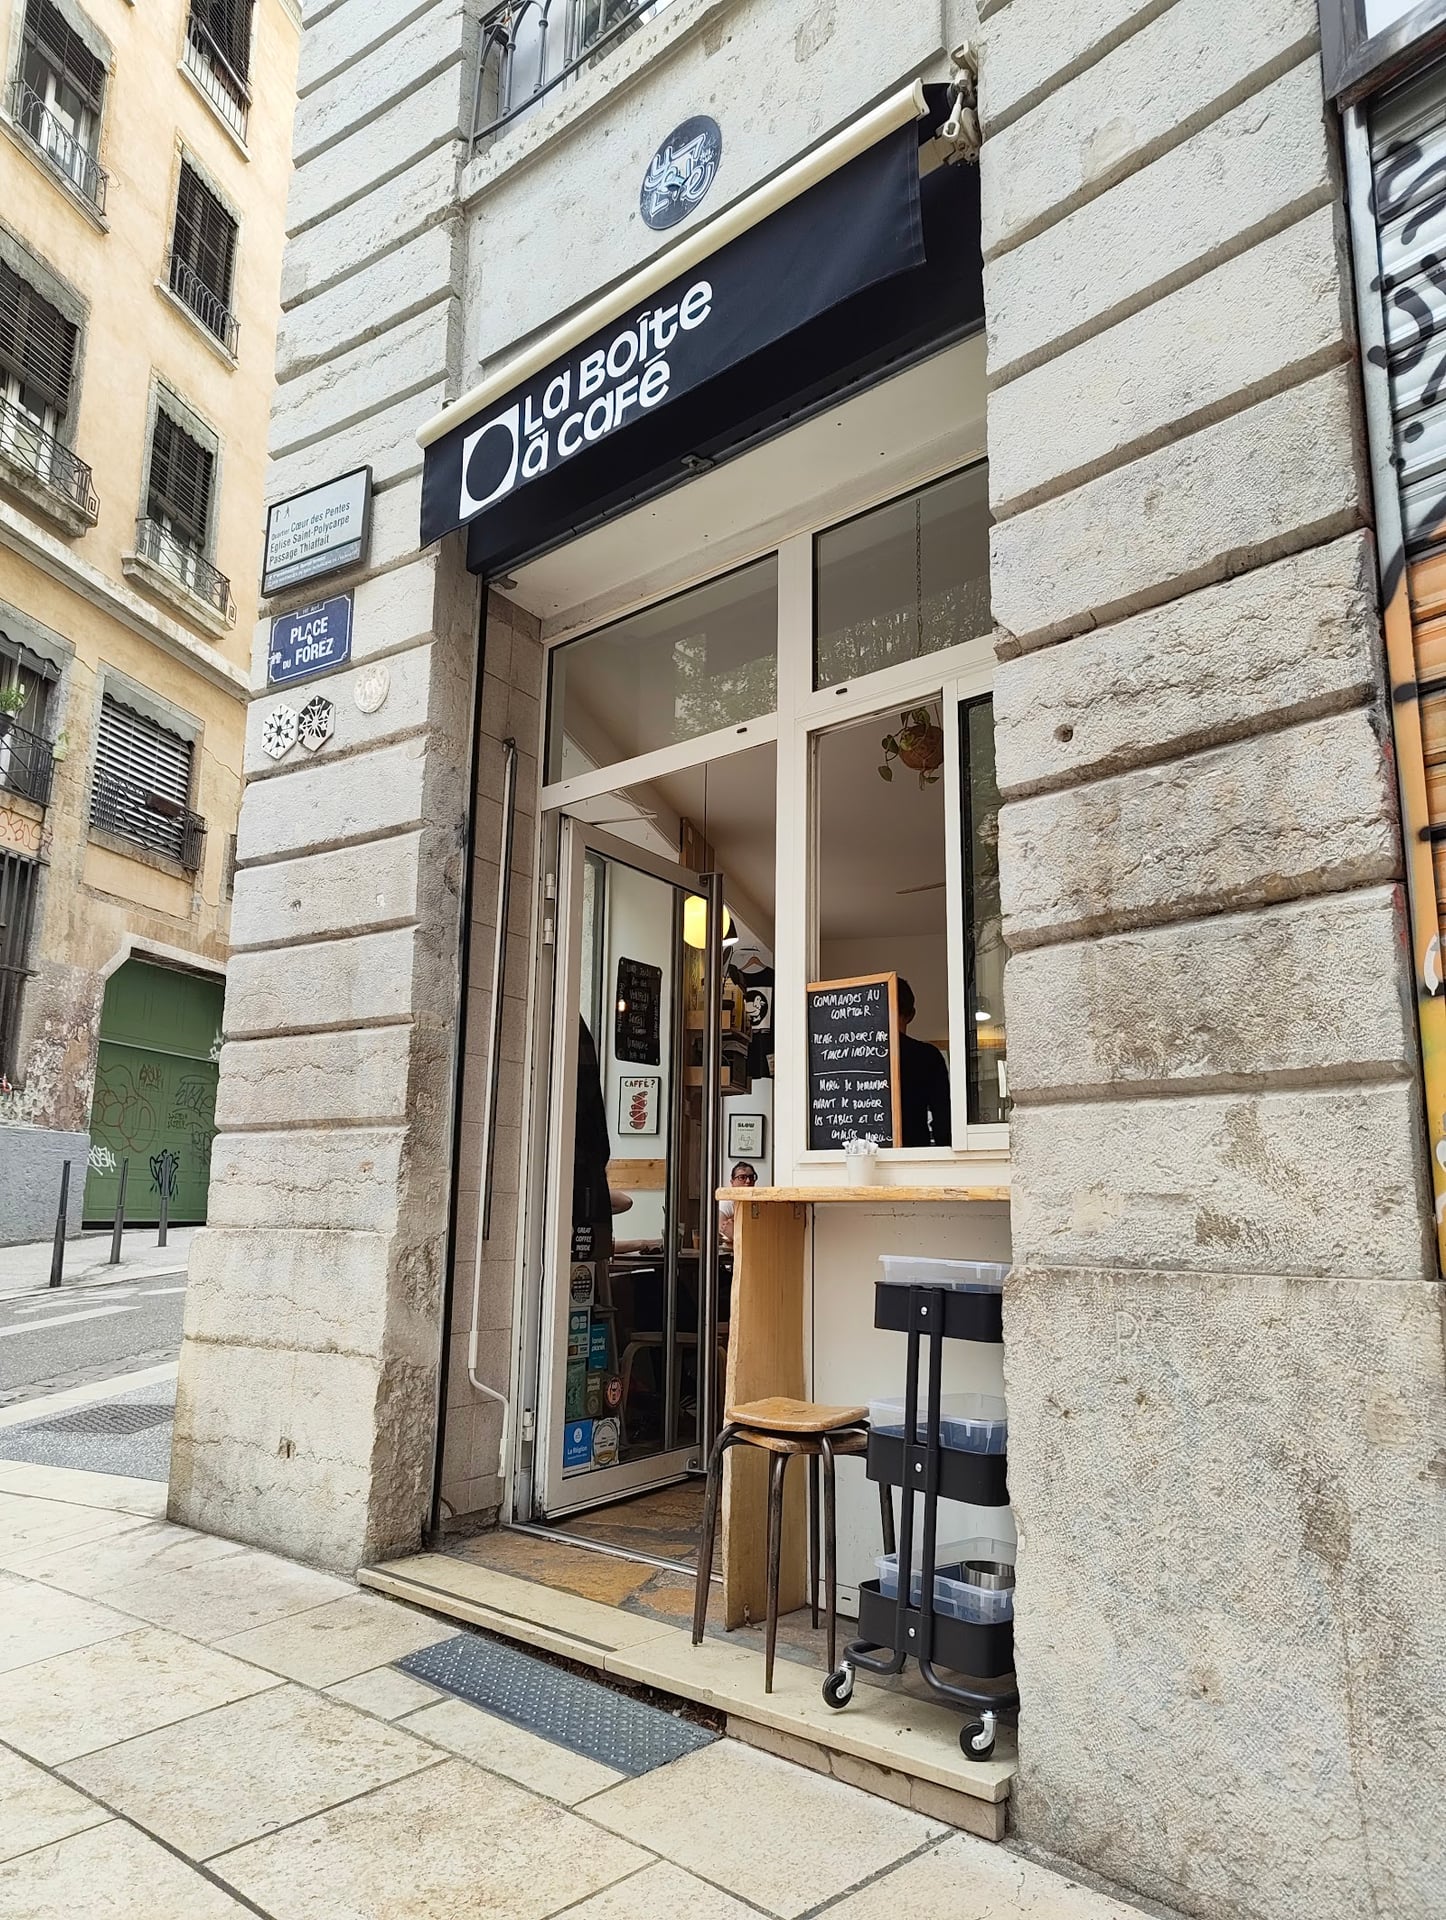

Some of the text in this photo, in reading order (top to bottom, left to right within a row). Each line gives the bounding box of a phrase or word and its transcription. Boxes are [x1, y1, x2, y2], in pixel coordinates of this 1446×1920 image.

[524, 370, 571, 435] La
[290, 518, 310, 533] Cœur
[310, 513, 324, 526] des
[324, 502, 350, 519] Pentes
[270, 515, 350, 553] Eglise Saint-Polycarpe
[268, 548, 298, 565] Passage
[290, 616, 329, 645] PLACE
[282, 637, 334, 670] DU FOREZ
[867, 989, 880, 1001] AU
[575, 1235, 592, 1243] COFFEE
[575, 1244, 591, 1252] INSIDE
